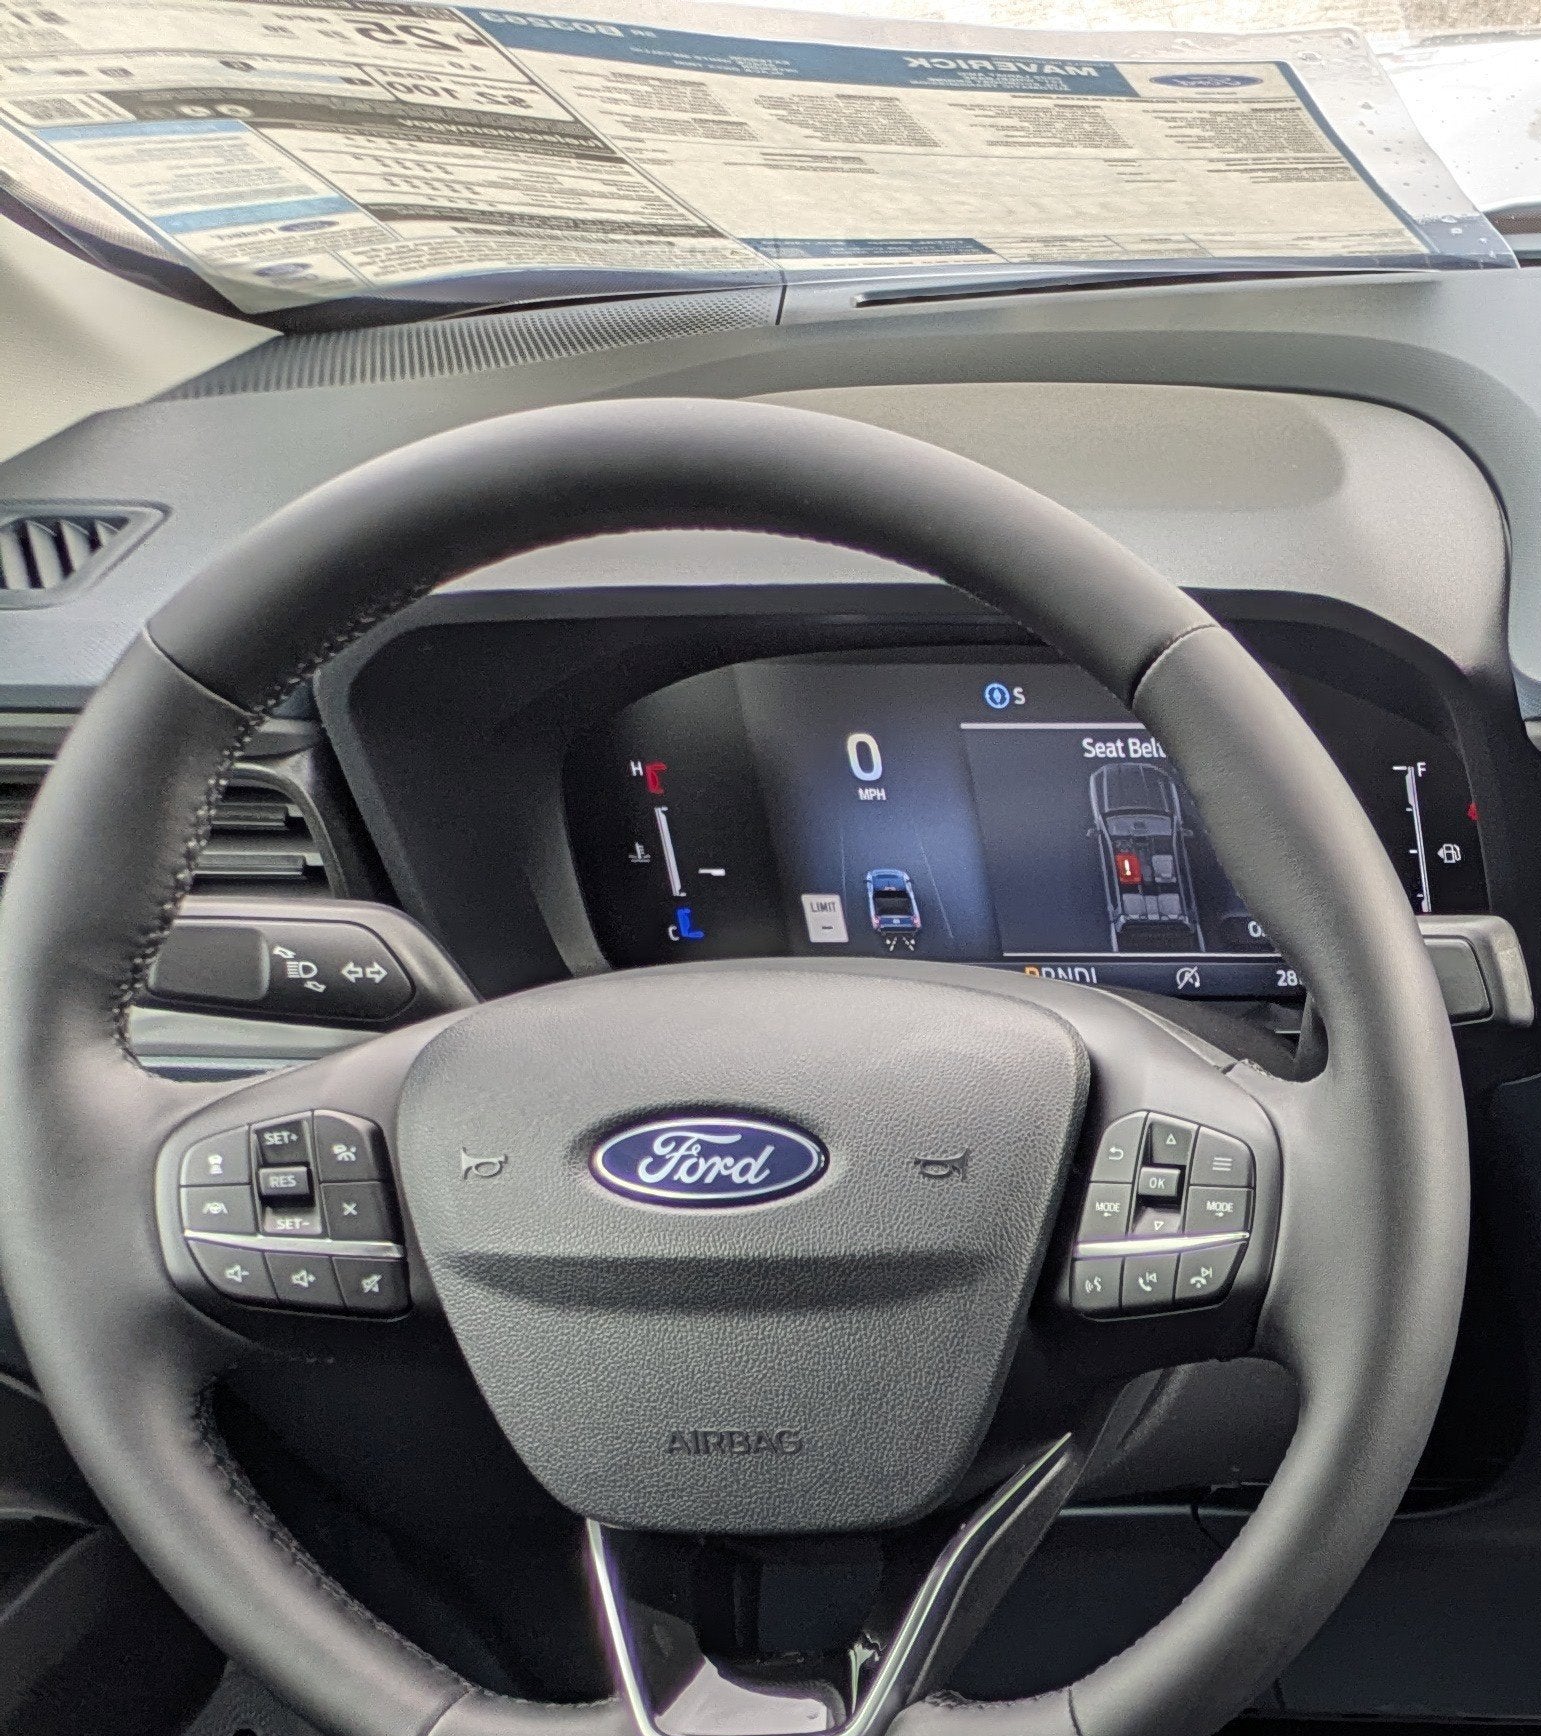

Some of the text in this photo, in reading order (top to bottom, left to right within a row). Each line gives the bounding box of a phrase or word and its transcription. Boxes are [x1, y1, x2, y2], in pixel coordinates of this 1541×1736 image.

[1081, 738, 1124, 759] Seat
[846, 732, 883, 782] 0
[629, 760, 644, 777] H
[857, 787, 886, 801] MPH
[809, 901, 837, 914] LIMIT
[667, 925, 680, 942] C
[637, 1130, 775, 1185] Ford
[269, 1175, 296, 1188] RES
[1149, 1178, 1165, 1190] OK
[1096, 1201, 1120, 1213] MODE
[1206, 1201, 1233, 1213] MODE
[665, 1430, 802, 1456] AIRBAG
